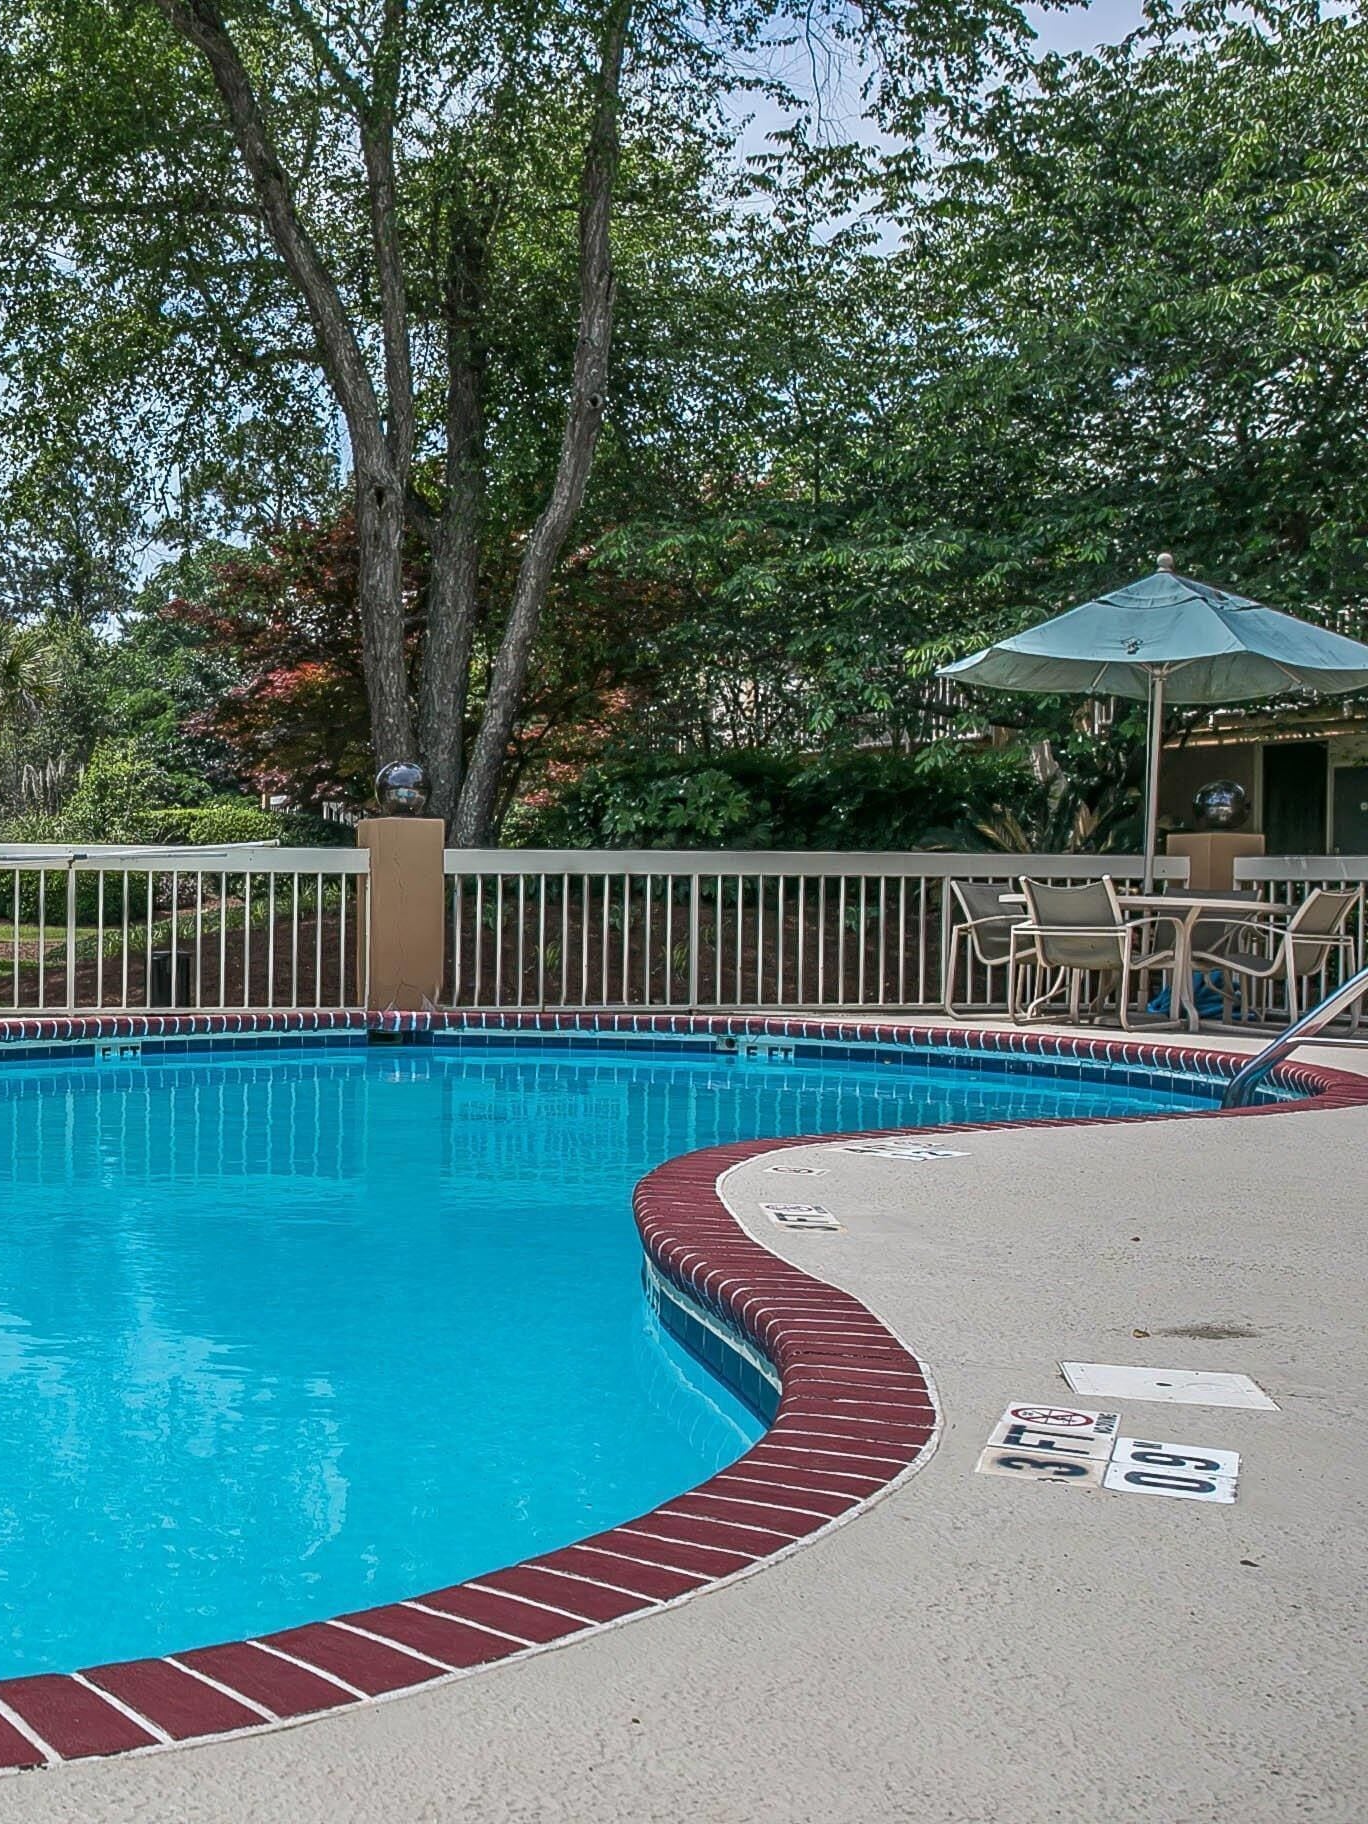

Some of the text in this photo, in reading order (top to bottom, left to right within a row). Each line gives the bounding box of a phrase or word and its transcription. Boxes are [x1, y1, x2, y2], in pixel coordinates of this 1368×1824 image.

[768, 1046, 793, 1058] FT
[997, 1423, 1095, 1477] 3 FT
